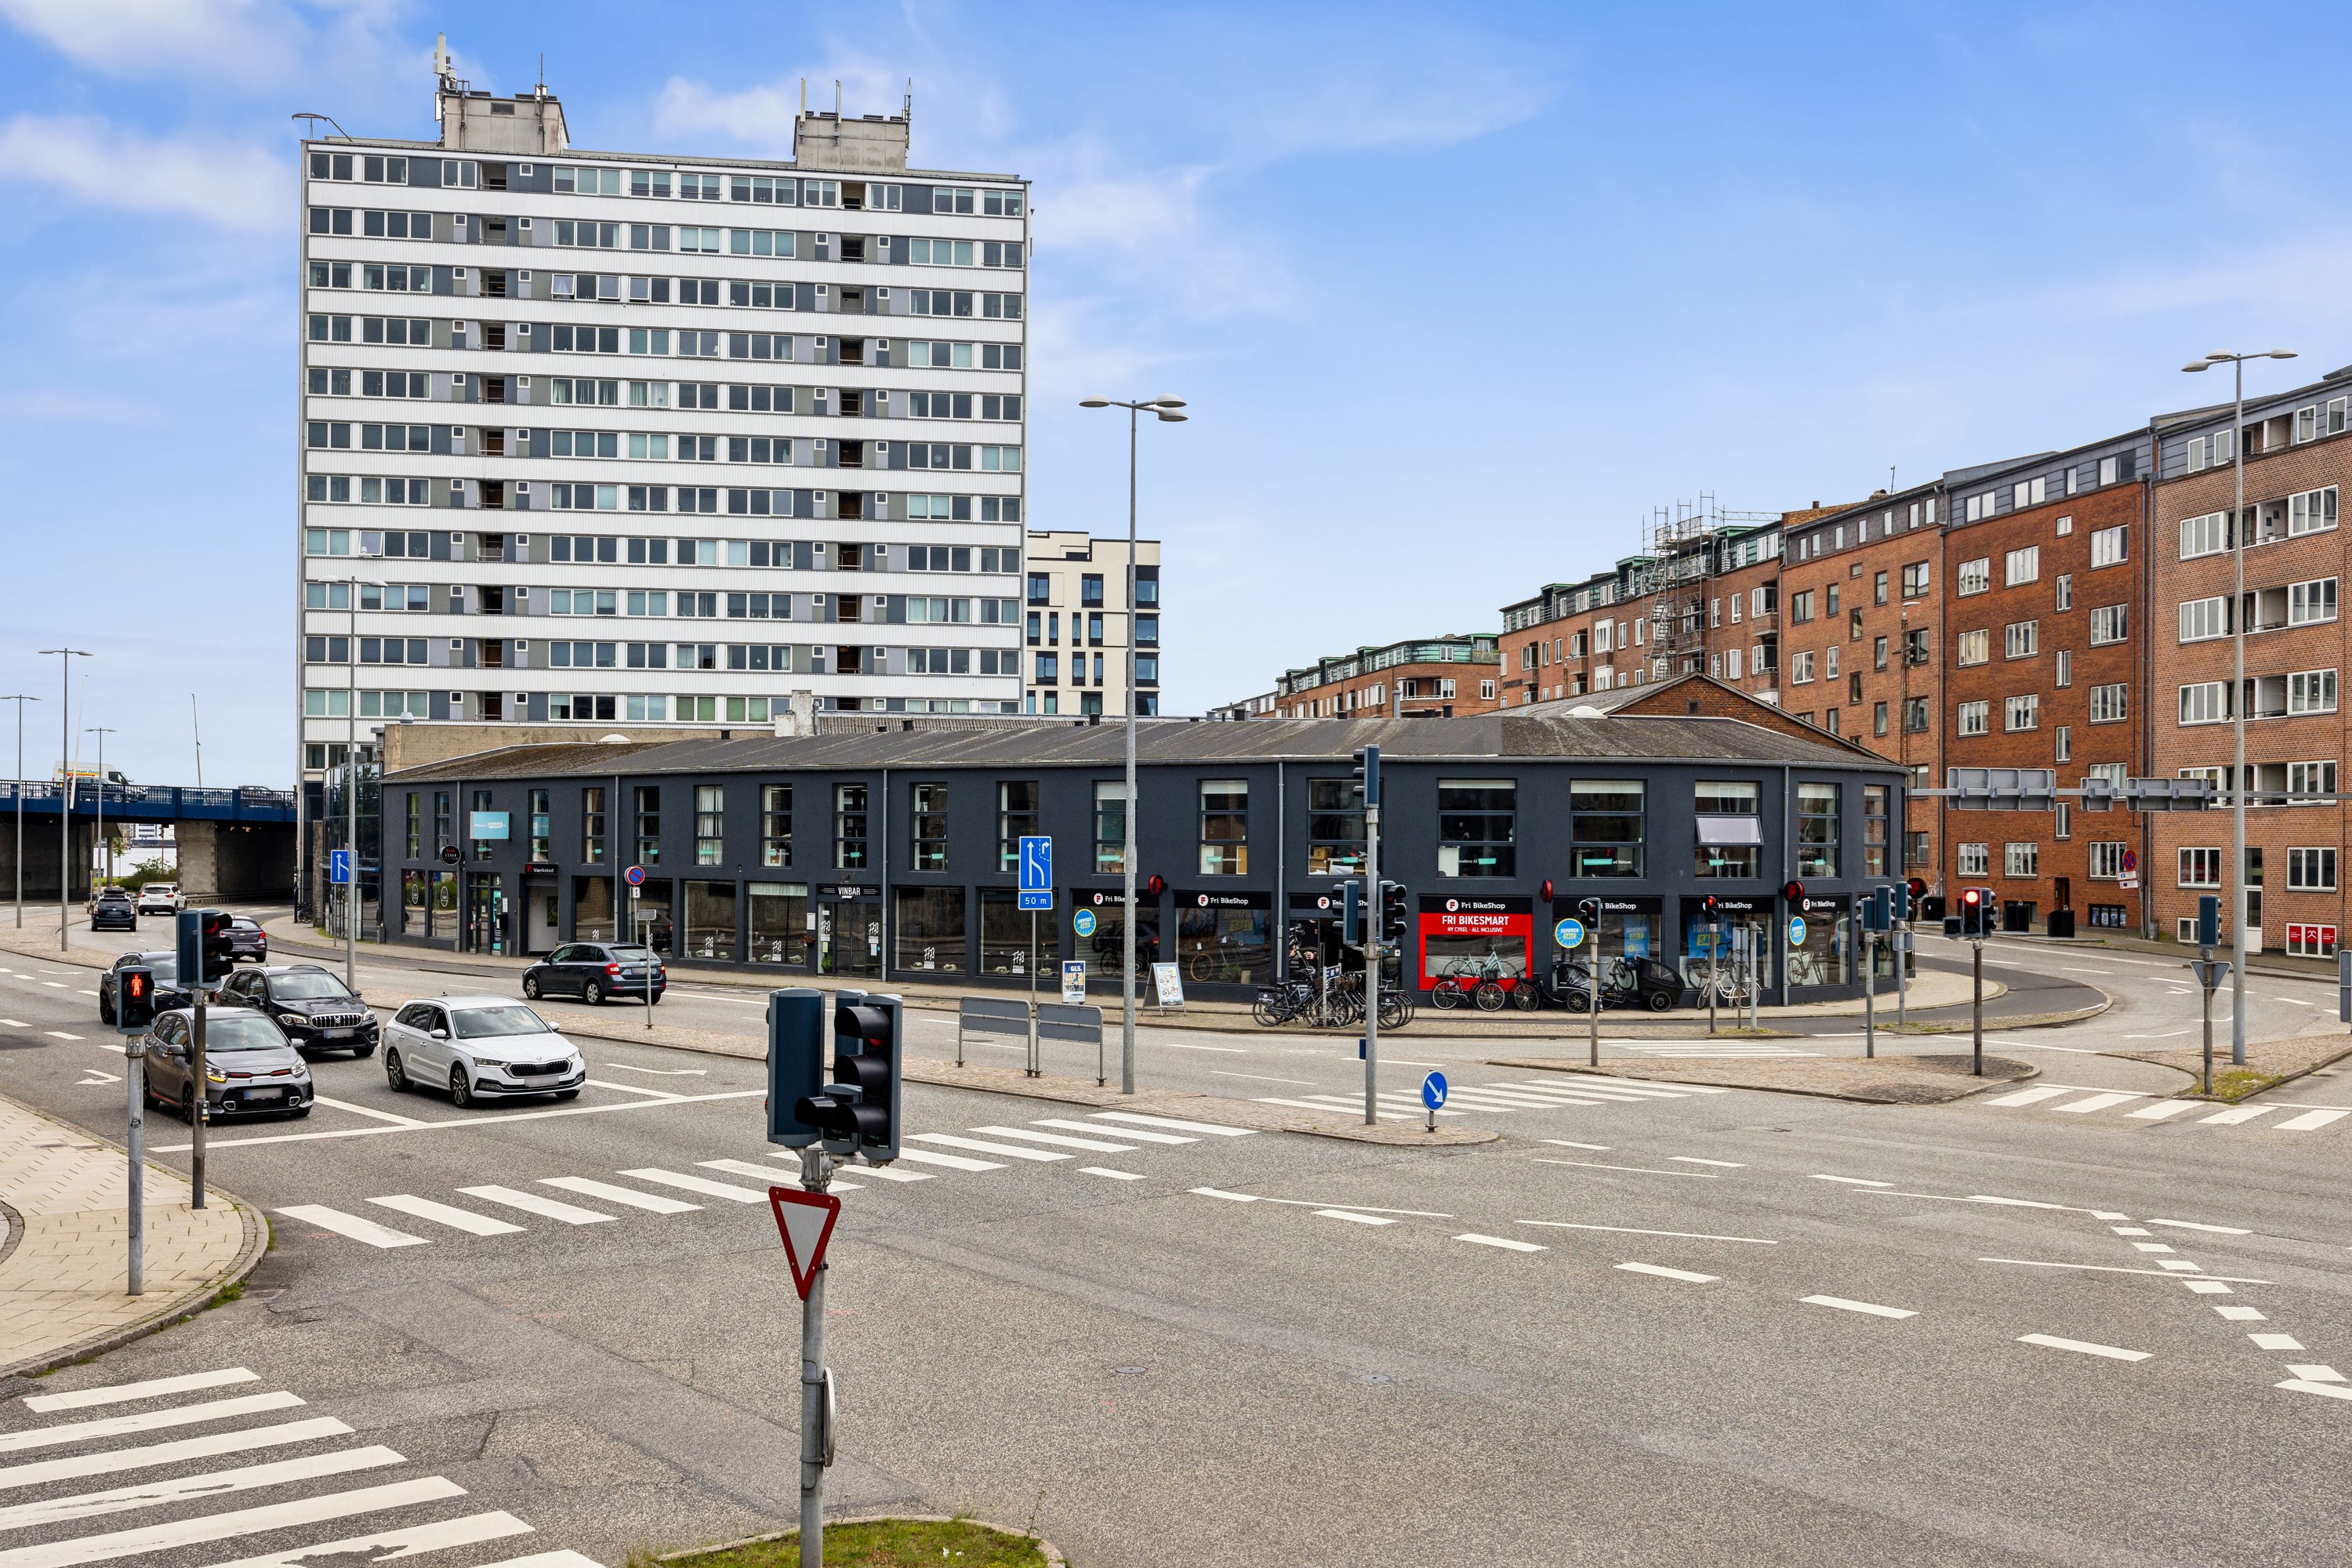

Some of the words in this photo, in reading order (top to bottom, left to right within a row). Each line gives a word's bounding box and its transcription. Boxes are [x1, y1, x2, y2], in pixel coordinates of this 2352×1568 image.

[837, 887, 861, 895] VINBAR
[1220, 897, 1248, 906] BikeShop
[1472, 902, 1505, 910] BikeShop
[1442, 915, 1456, 925] FRI
[1458, 916, 1509, 926] BIKESMART
[1693, 923, 1726, 933] SUMER
